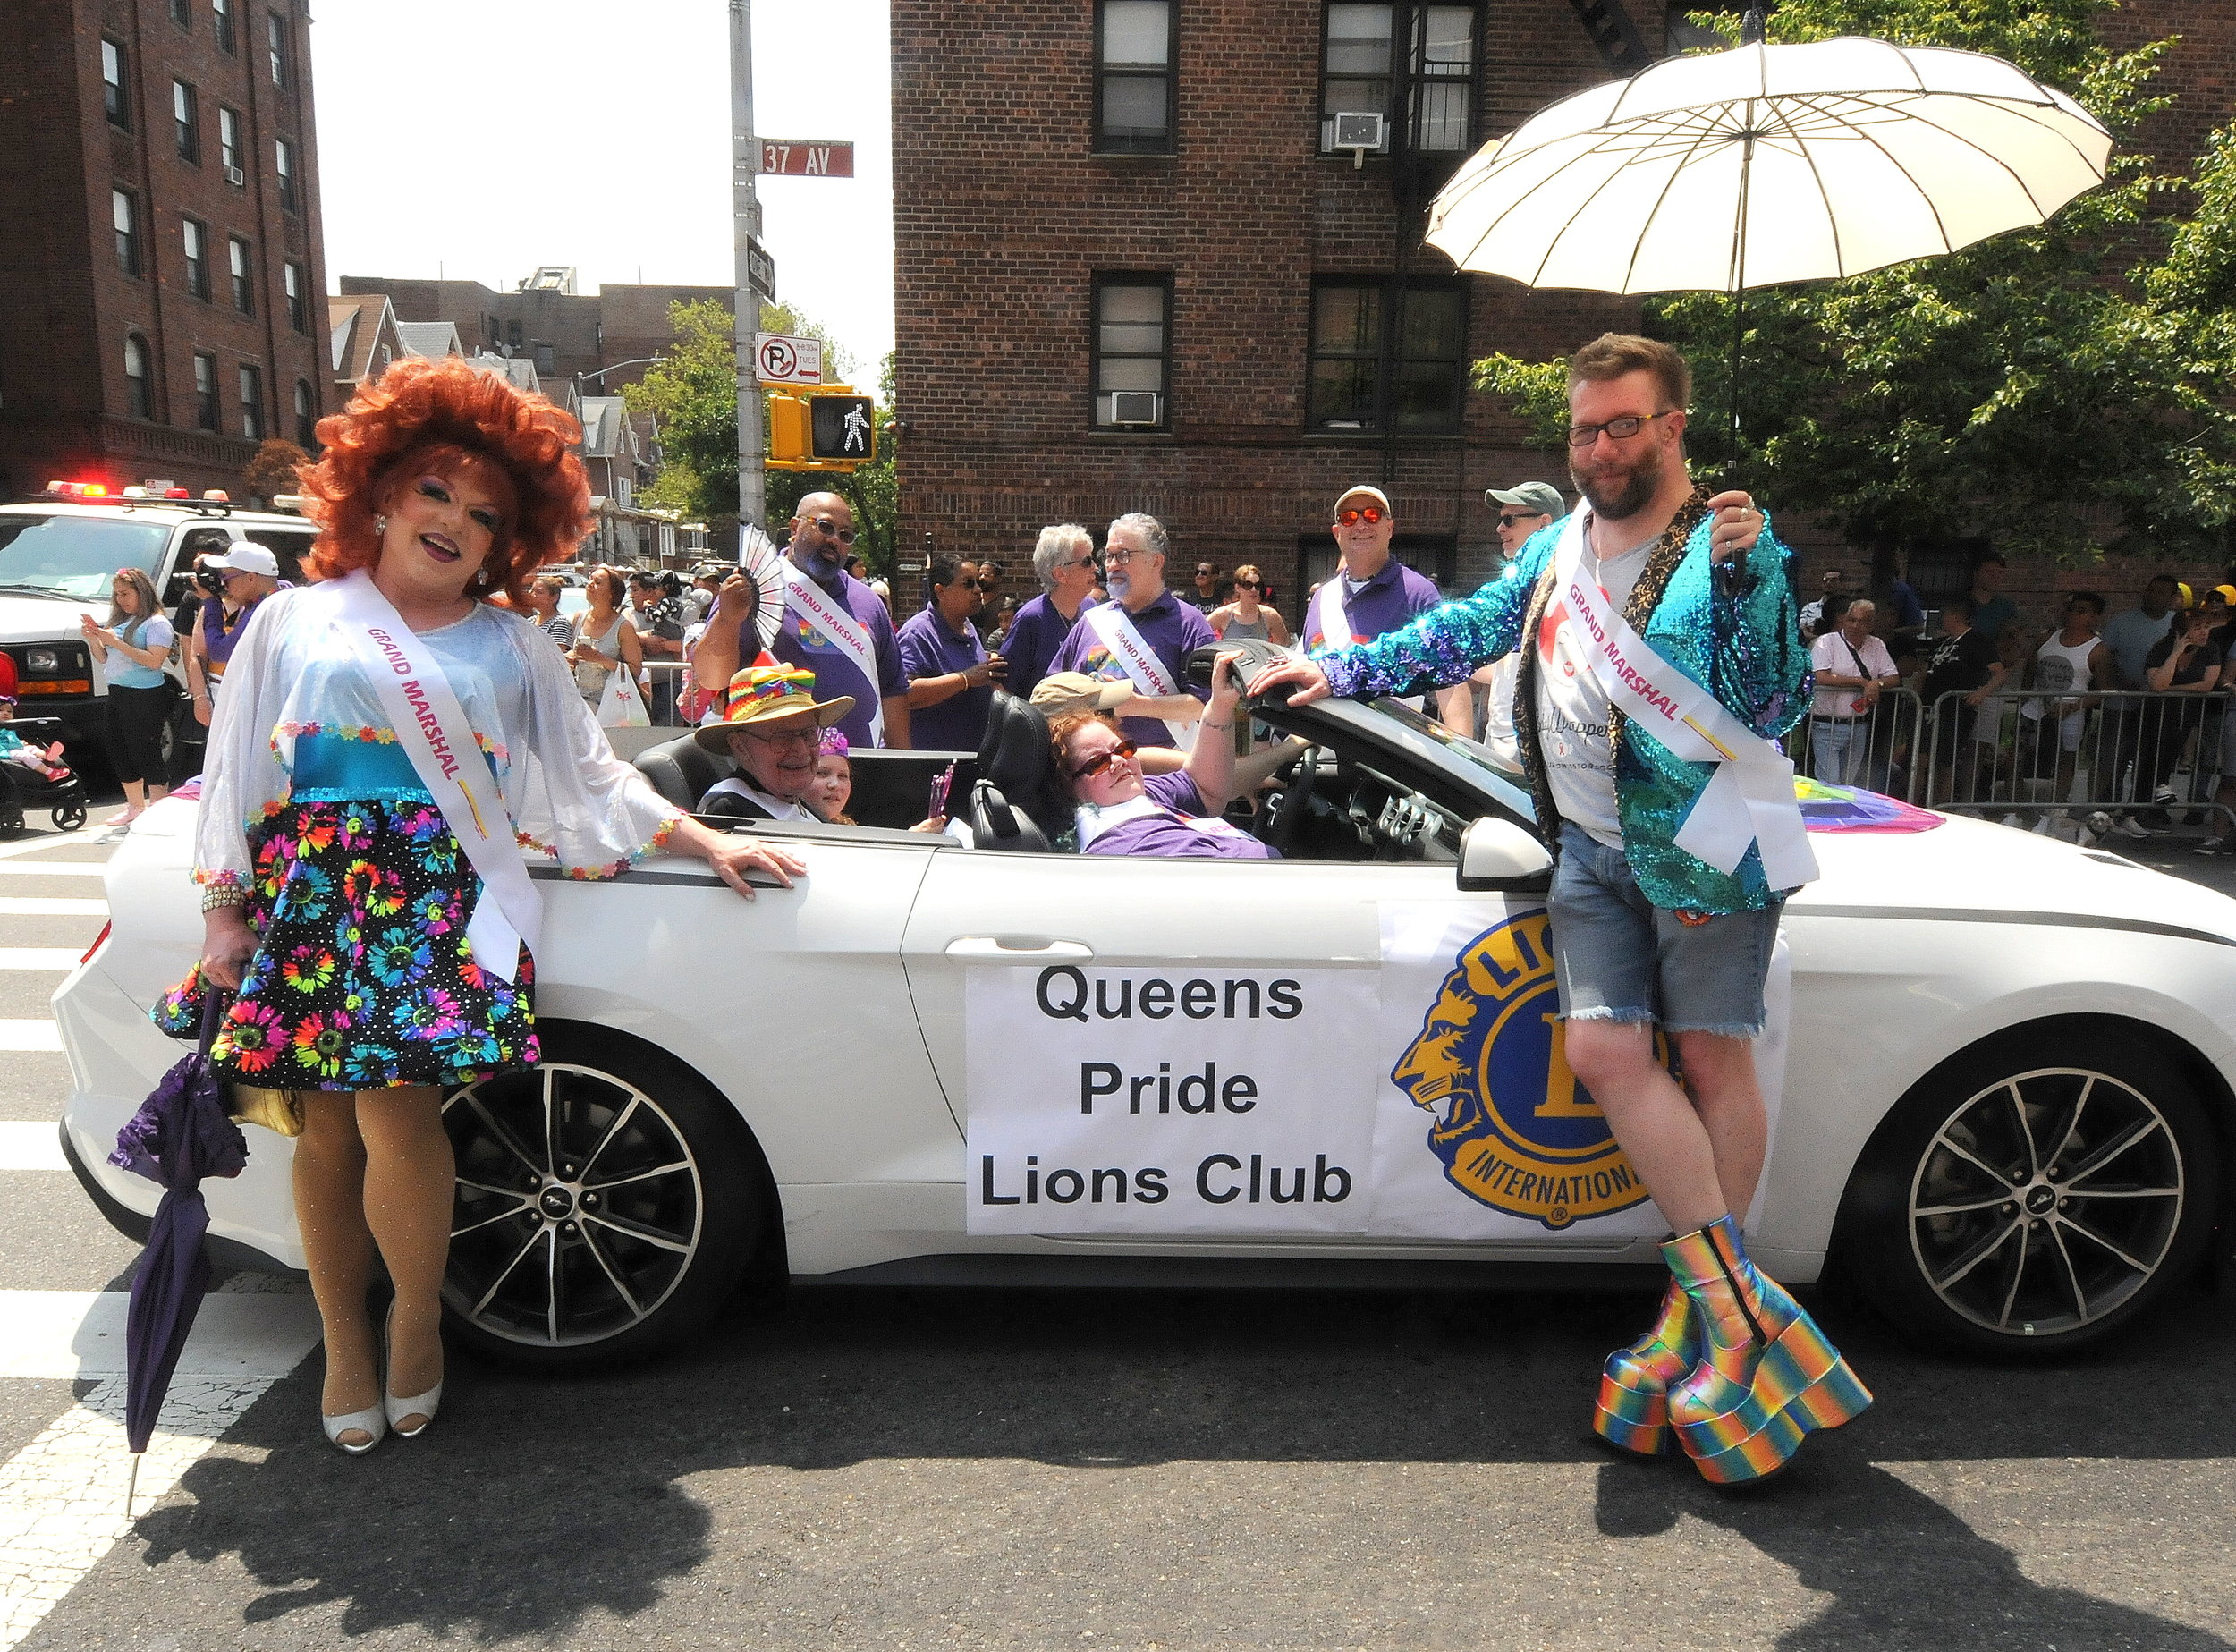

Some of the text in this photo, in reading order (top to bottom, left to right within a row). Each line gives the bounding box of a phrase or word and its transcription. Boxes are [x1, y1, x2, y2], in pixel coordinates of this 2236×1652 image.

[766, 145, 830, 174] 37 AV
[799, 356, 816, 364] TUES
[788, 581, 866, 655] GRAND MARSHAL
[1114, 629, 1168, 695] GRAND MARSHA
[1570, 584, 1680, 721] GRAND MARSHAL
[368, 629, 459, 780] GRAND MARSHAL
[1035, 965, 1303, 1023] Queens
[1080, 1062, 1258, 1114] Pride
[982, 1154, 1351, 1205] Lions Club
